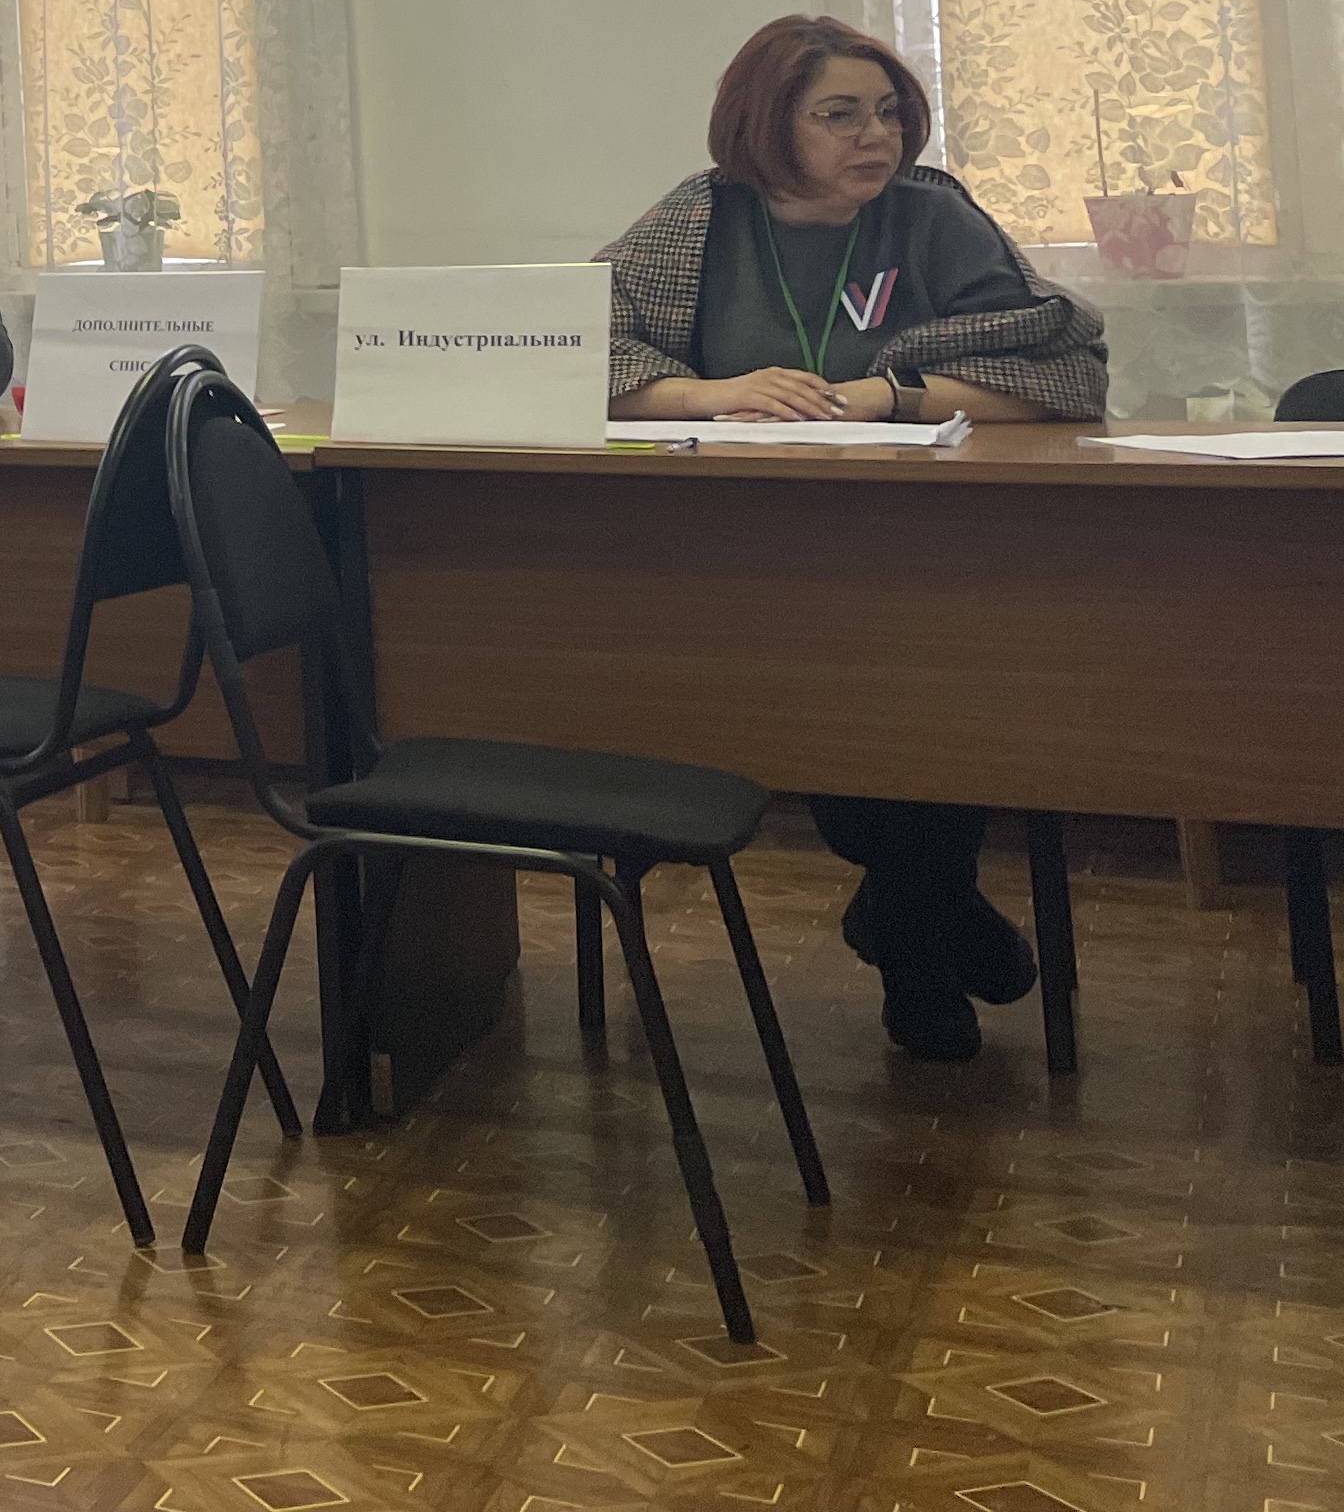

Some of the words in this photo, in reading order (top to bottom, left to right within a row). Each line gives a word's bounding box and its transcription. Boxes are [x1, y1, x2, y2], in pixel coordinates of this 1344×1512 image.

[72, 319, 215, 333] ДОПОЛНИТЕЛЬНЫЕ
[354, 333, 385, 351] ул.
[398, 330, 582, 351] Индустриальная
[109, 360, 152, 372] СПИС
